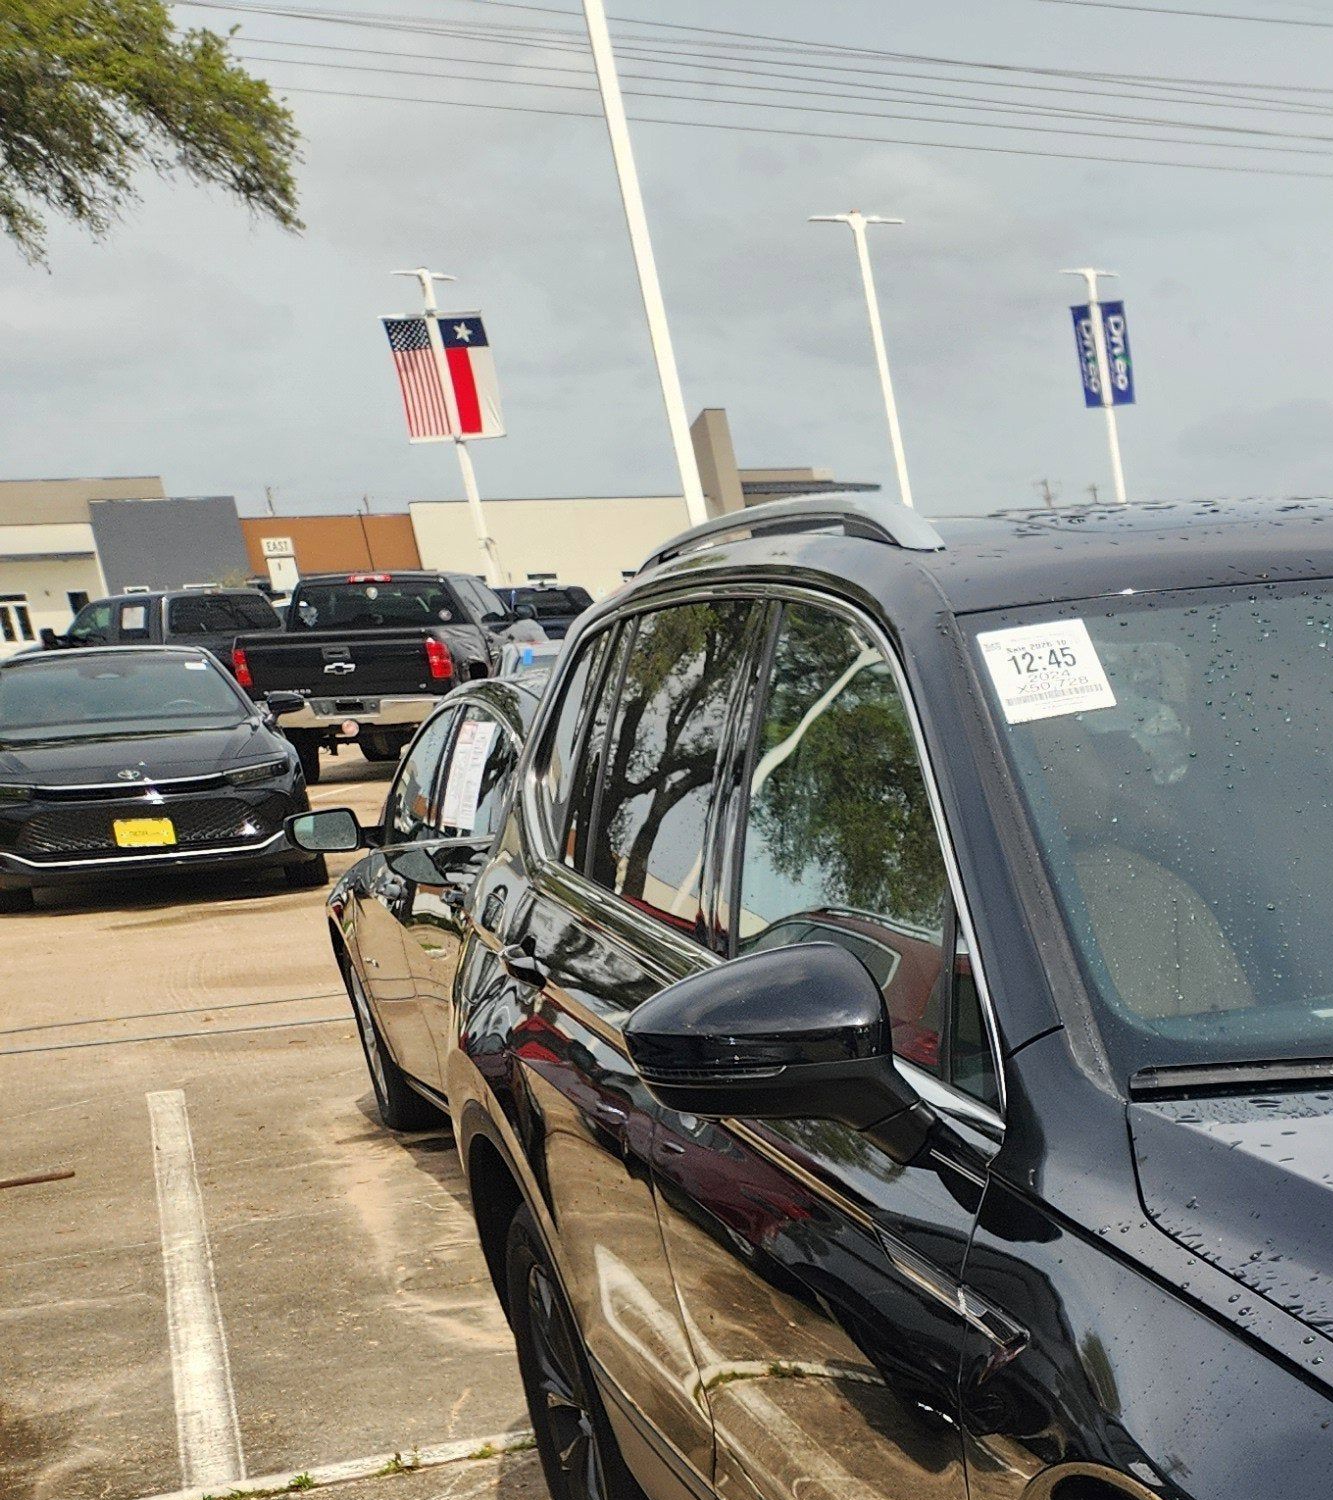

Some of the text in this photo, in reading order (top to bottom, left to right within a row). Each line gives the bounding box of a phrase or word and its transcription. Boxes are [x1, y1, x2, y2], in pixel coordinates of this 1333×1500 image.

[266, 540, 288, 552] EAST
[1007, 646, 1077, 675] 12:45
[1028, 669, 1071, 682] 2024
[1059, 676, 1089, 687] 728
